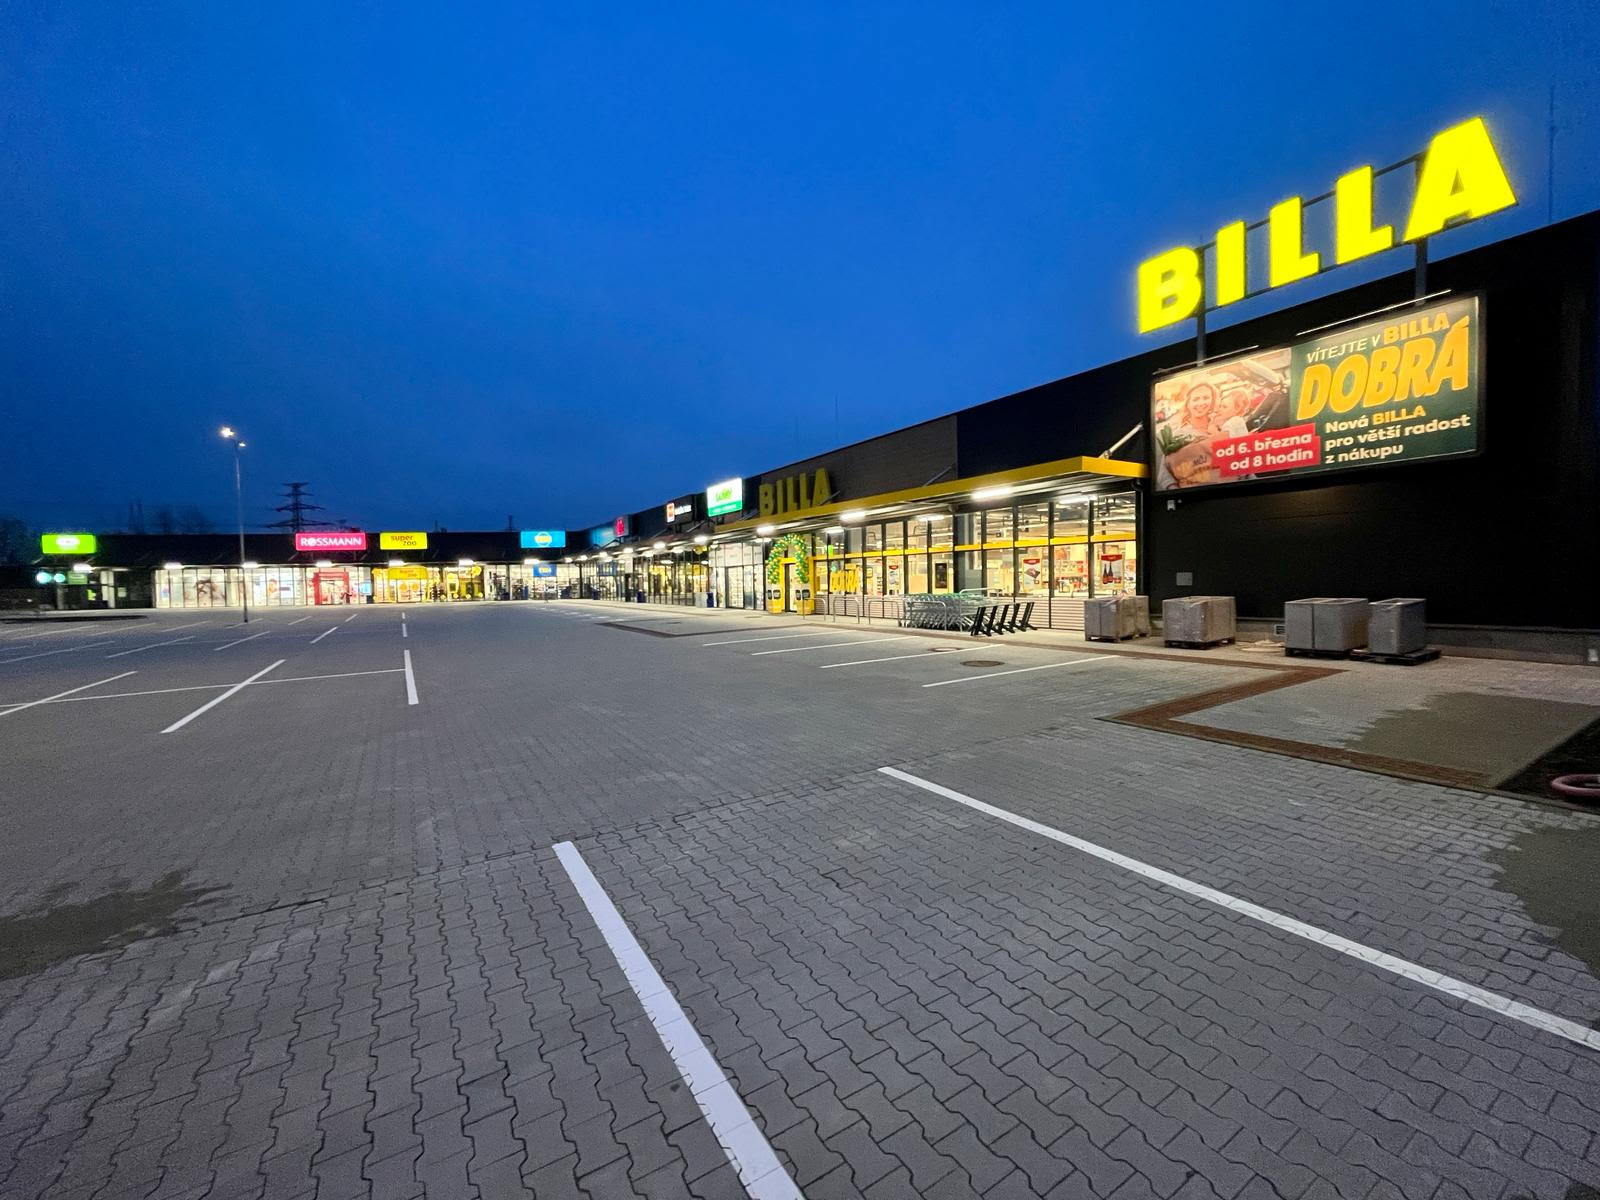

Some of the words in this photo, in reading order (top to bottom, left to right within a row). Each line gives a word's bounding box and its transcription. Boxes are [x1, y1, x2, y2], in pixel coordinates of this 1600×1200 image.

[1137, 116, 1518, 334] BILLA
[1306, 337, 1368, 363] VÍTEJTE
[1371, 334, 1381, 347] V
[1383, 311, 1450, 345] BILLA
[1296, 315, 1471, 420] DOBRÁ
[1325, 415, 1369, 433] Nová
[1373, 405, 1427, 425] BILLA
[1325, 436, 1354, 452] pro
[1357, 424, 1401, 442] větší
[1405, 414, 1471, 436] radost
[1215, 443, 1236, 458] od
[1238, 441, 1252, 455] 6.
[1254, 432, 1313, 450] března
[1325, 454, 1335, 464] z
[1338, 444, 1404, 463] nákupu
[1230, 457, 1250, 471] od
[1253, 456, 1263, 468] 8
[1266, 448, 1313, 466] hodin
[759, 467, 832, 516] BILLA
[300, 537, 362, 547] ROSSMANN
[390, 535, 413, 543] super
